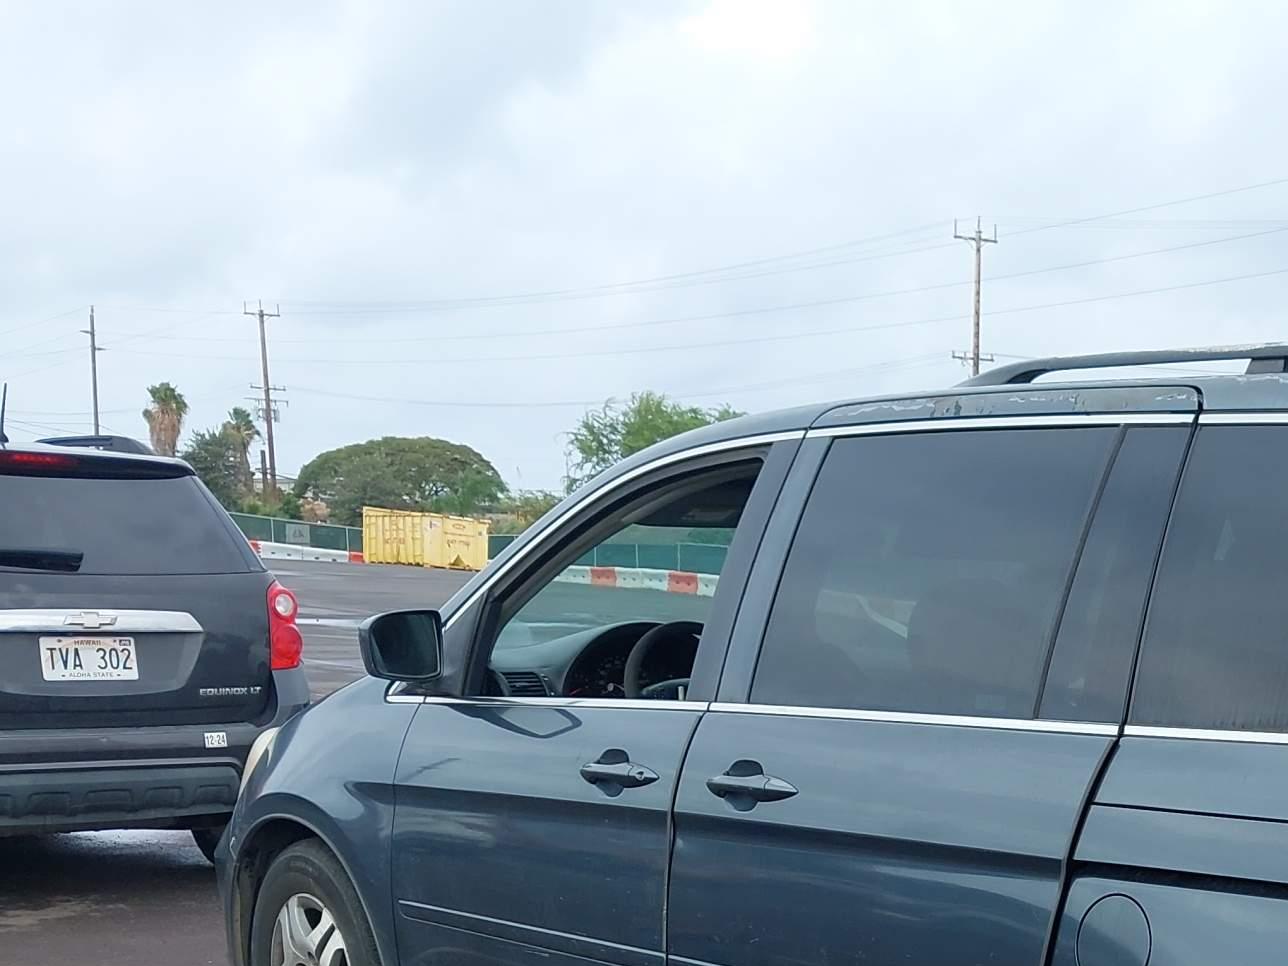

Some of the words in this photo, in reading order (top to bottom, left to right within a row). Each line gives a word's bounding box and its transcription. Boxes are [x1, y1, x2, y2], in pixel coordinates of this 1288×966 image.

[46, 647, 83, 670] TVA
[96, 647, 133, 670] 302
[200, 687, 248, 696] EQUINOX
[250, 686, 262, 694] LT
